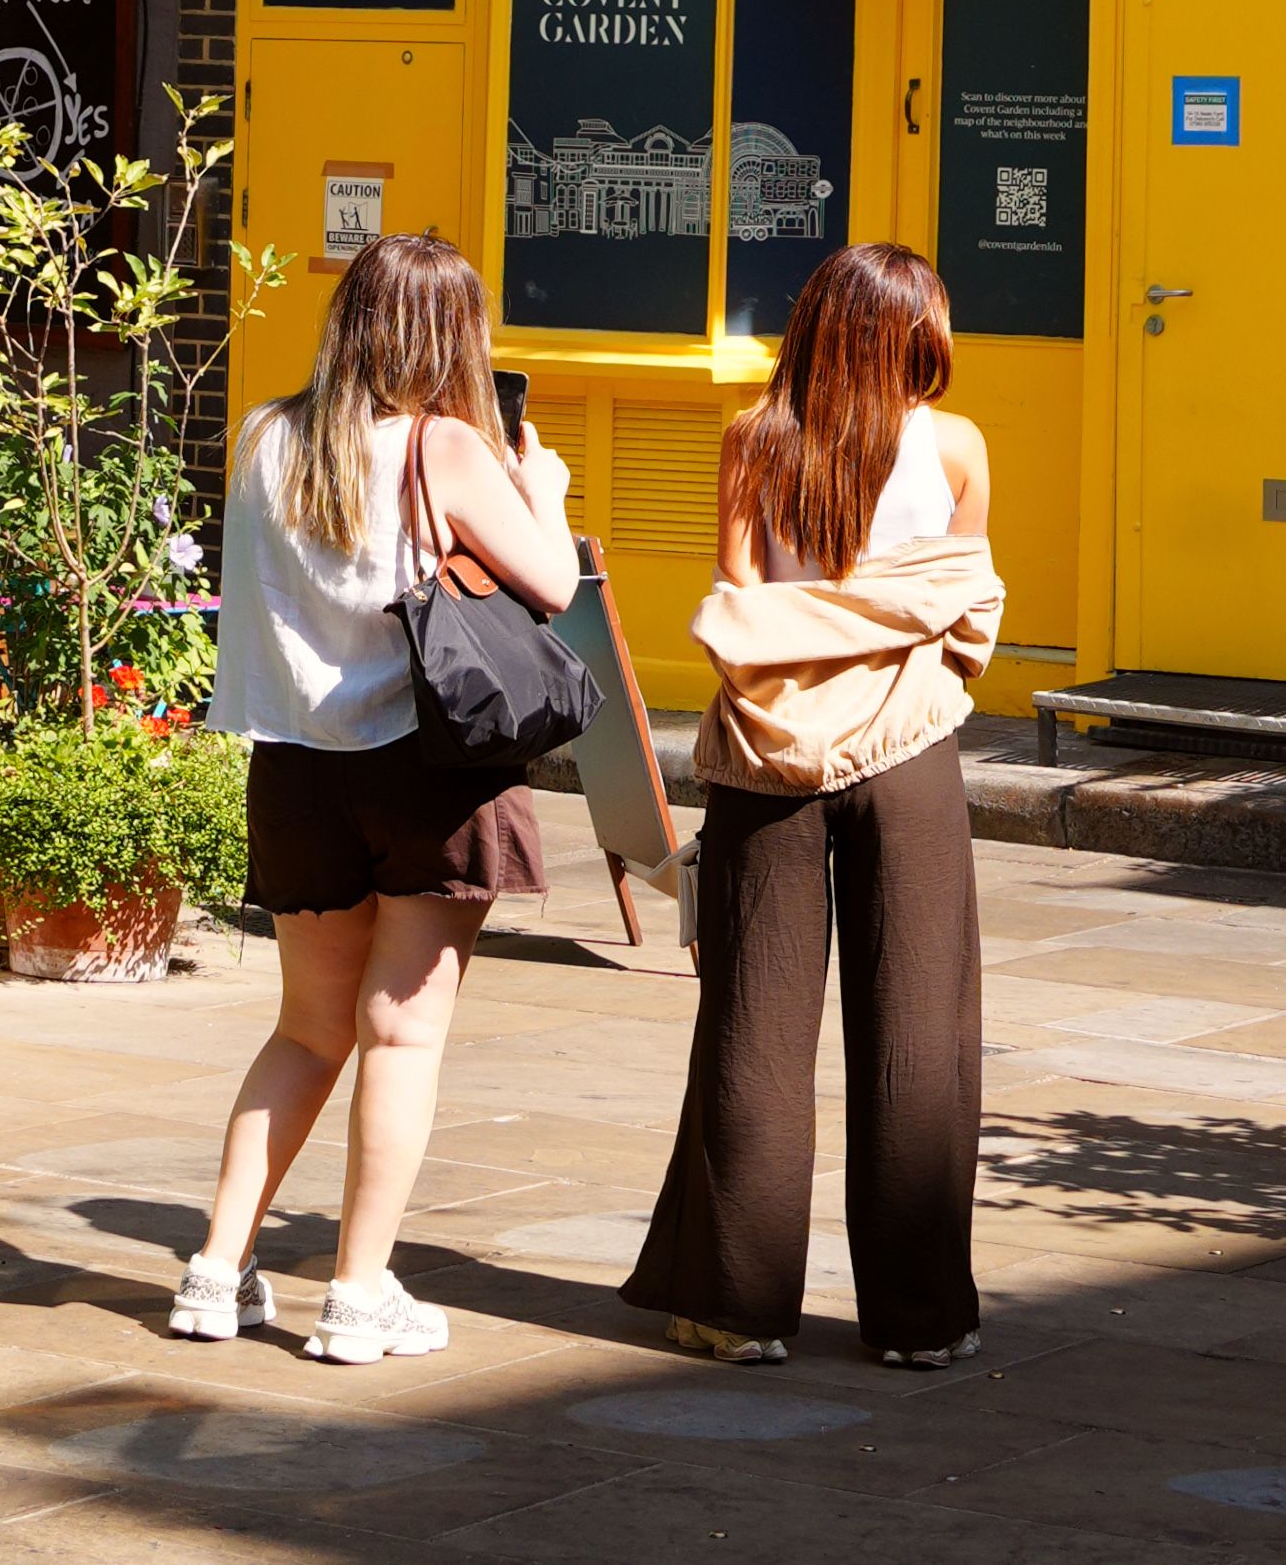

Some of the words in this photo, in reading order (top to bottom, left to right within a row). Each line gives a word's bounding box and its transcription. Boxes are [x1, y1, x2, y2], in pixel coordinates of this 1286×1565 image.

[538, 12, 688, 45] GARDEN
[961, 91, 982, 101] Scan
[984, 93, 994, 101] to
[995, 92, 1032, 102] discover
[1034, 95, 1058, 103] more
[1060, 94, 1086, 104] about
[963, 104, 996, 114] Covent
[997, 105, 1030, 115] Garden
[1032, 106, 1075, 118] including
[65, 93, 109, 146] YES
[954, 117, 974, 127] map
[975, 116, 986, 125] of
[987, 116, 1002, 126] the
[1003, 118, 1073, 129] neighbourhood
[980, 129, 1009, 139] what's
[1010, 131, 1022, 139] on
[1023, 130, 1041, 140] this
[1042, 131, 1066, 141] week
[330, 184, 382, 198] CAUTION
[328, 232, 365, 245] BEWARE
[978, 238, 1062, 252] @coventgardenldn
